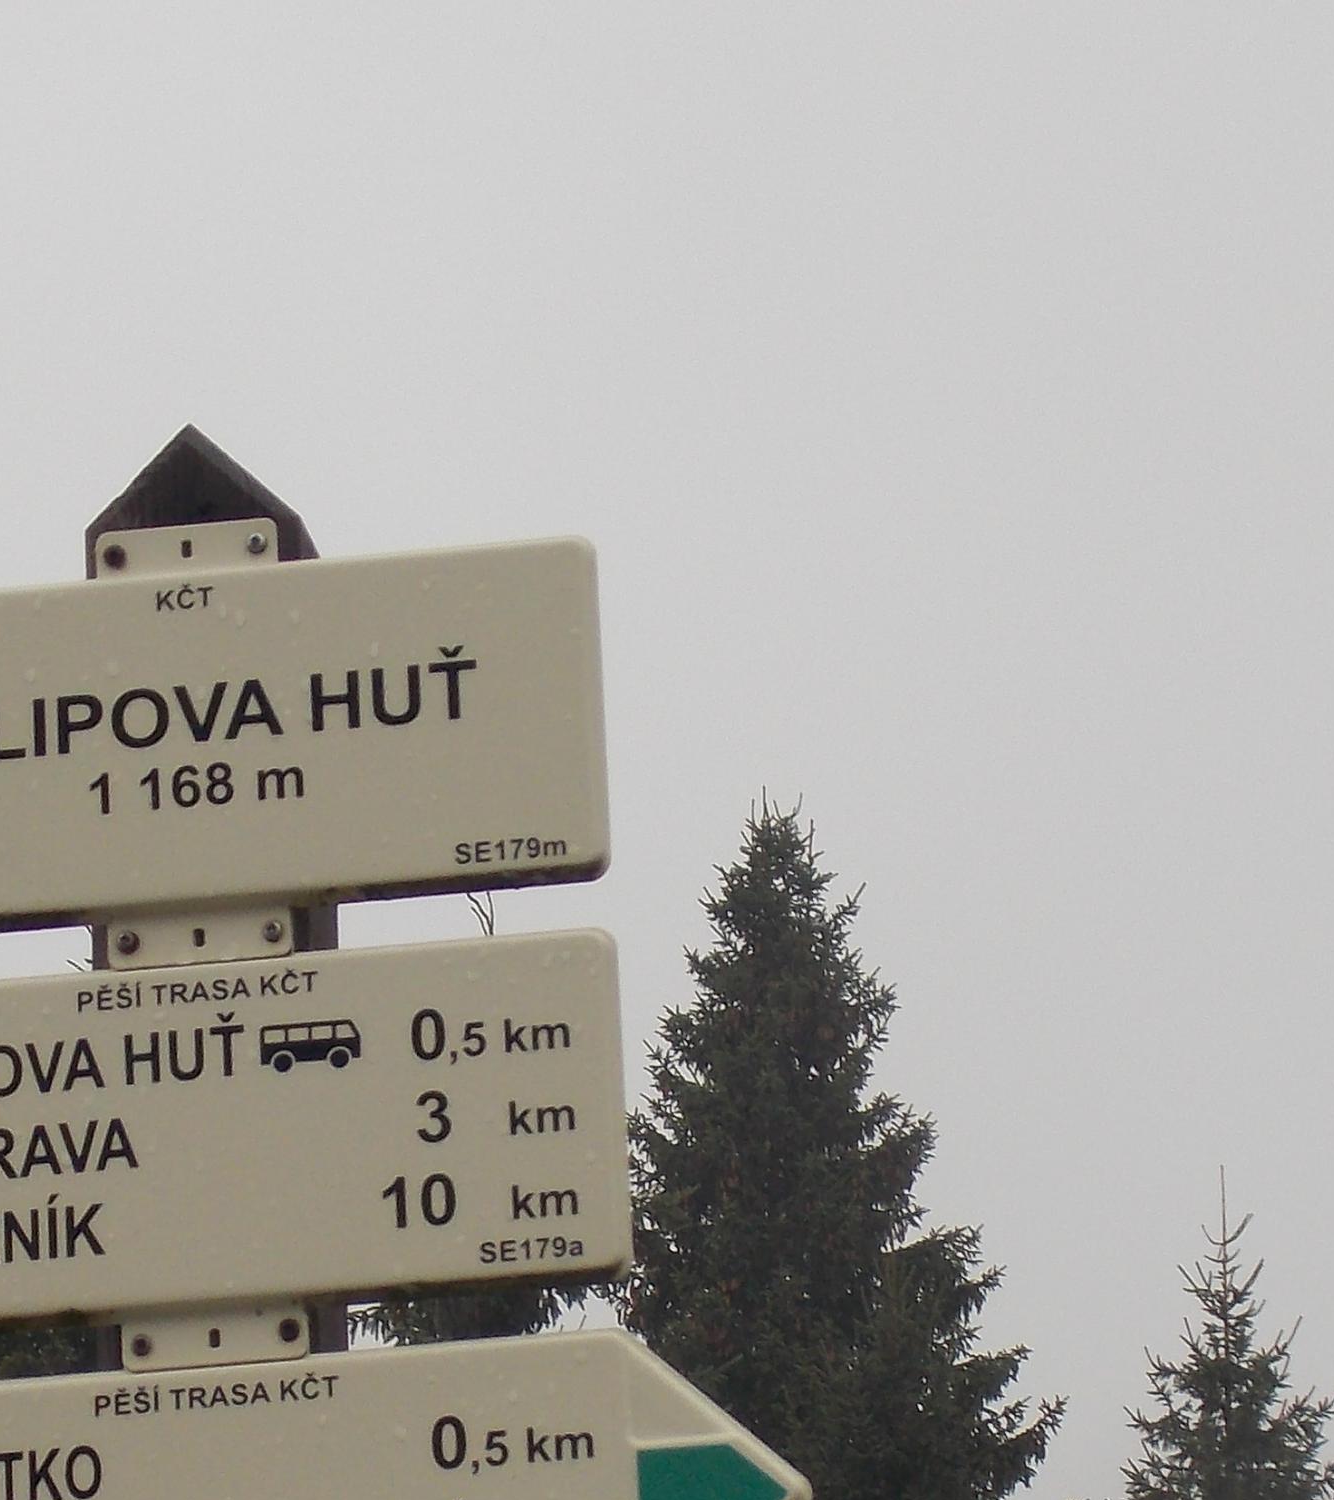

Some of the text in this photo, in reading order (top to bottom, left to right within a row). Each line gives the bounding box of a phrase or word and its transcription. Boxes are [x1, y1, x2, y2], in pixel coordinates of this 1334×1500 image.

[156, 584, 213, 611] KČT
[310, 645, 476, 732] HUŤ
[90, 762, 304, 814] 1 168 m
[455, 837, 566, 864] SE179m
[78, 968, 318, 1013] PĚŠÍ TRASA KČT
[124, 1012, 244, 1085] HUŤ
[411, 1009, 486, 1065] 0,5
[504, 1018, 570, 1053] km
[417, 1091, 451, 1143] 3
[509, 1101, 575, 1135] km
[383, 1173, 456, 1228] 10
[512, 1185, 578, 1219] km
[480, 1236, 583, 1263] SE179a
[95, 1372, 339, 1417] PĚŠÍ TRASA KČT
[432, 1416, 509, 1474] 0,5
[527, 1427, 594, 1463] km
